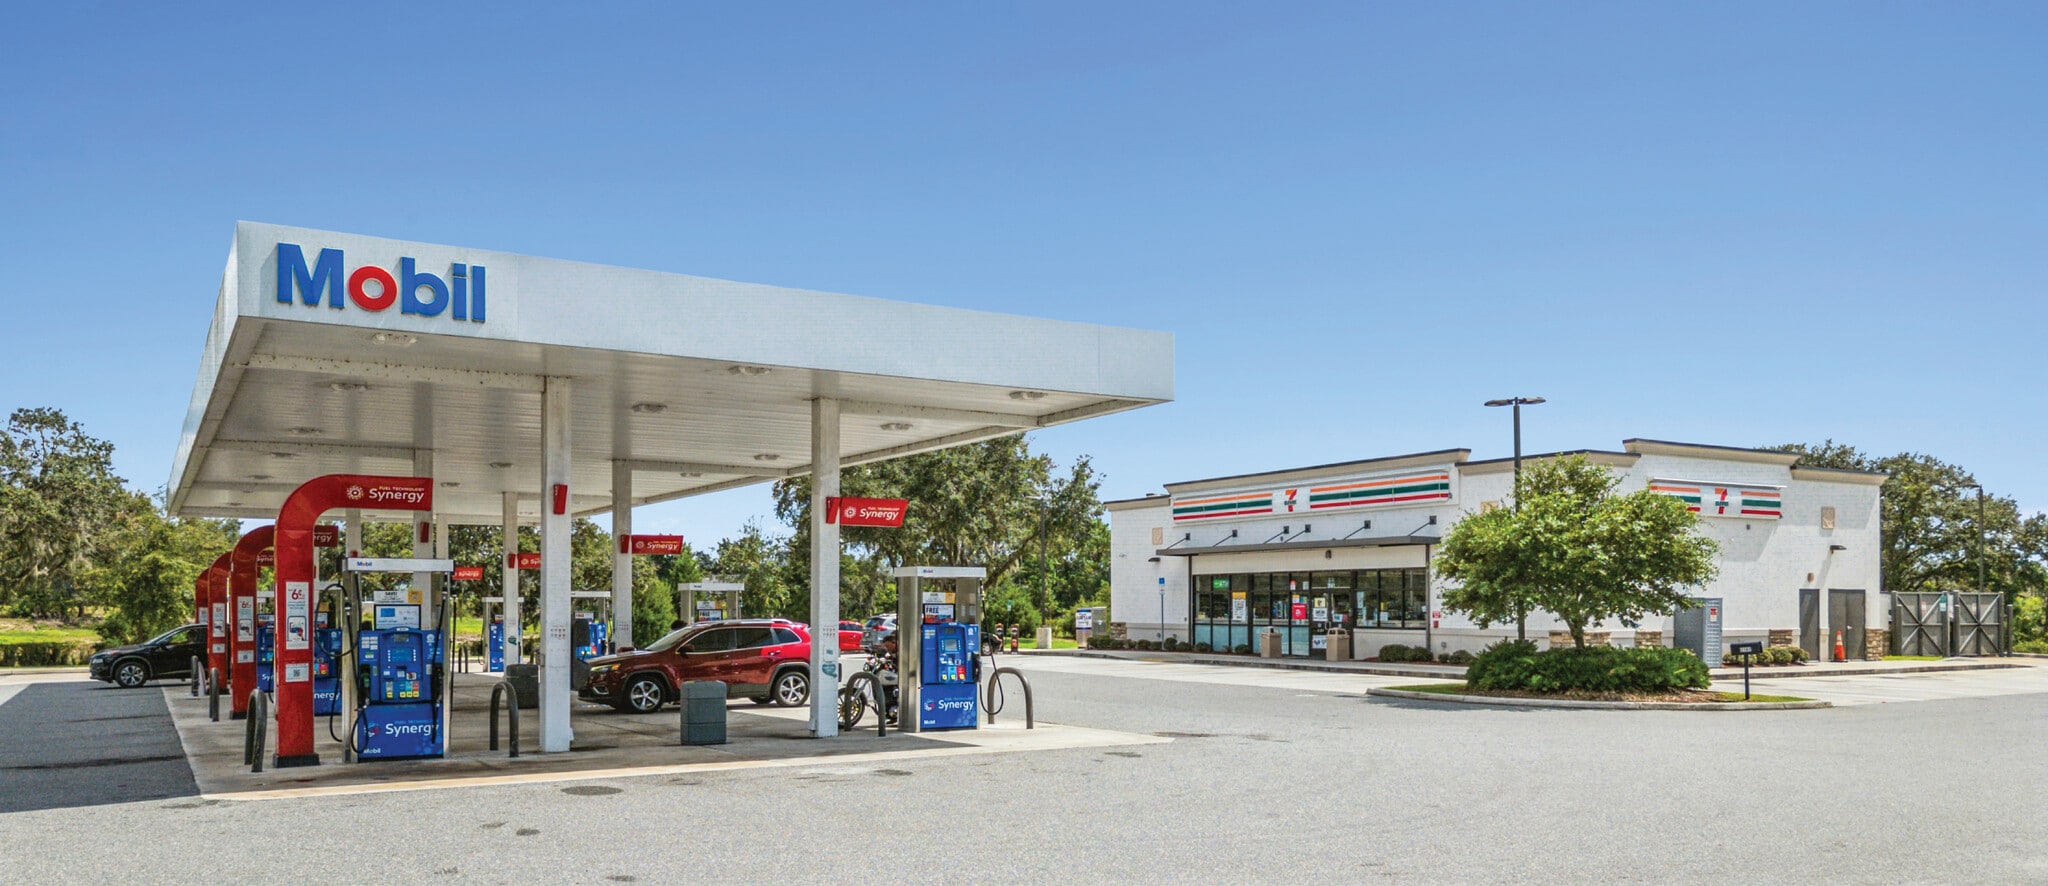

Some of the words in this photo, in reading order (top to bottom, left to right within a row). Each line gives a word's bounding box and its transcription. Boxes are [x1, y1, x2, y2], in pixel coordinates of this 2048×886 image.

[277, 242, 486, 323] Mobil
[369, 488, 424, 503] Synergy
[860, 508, 899, 521] Synergy
[647, 541, 678, 550] Synergy
[938, 700, 974, 711] Synergy
